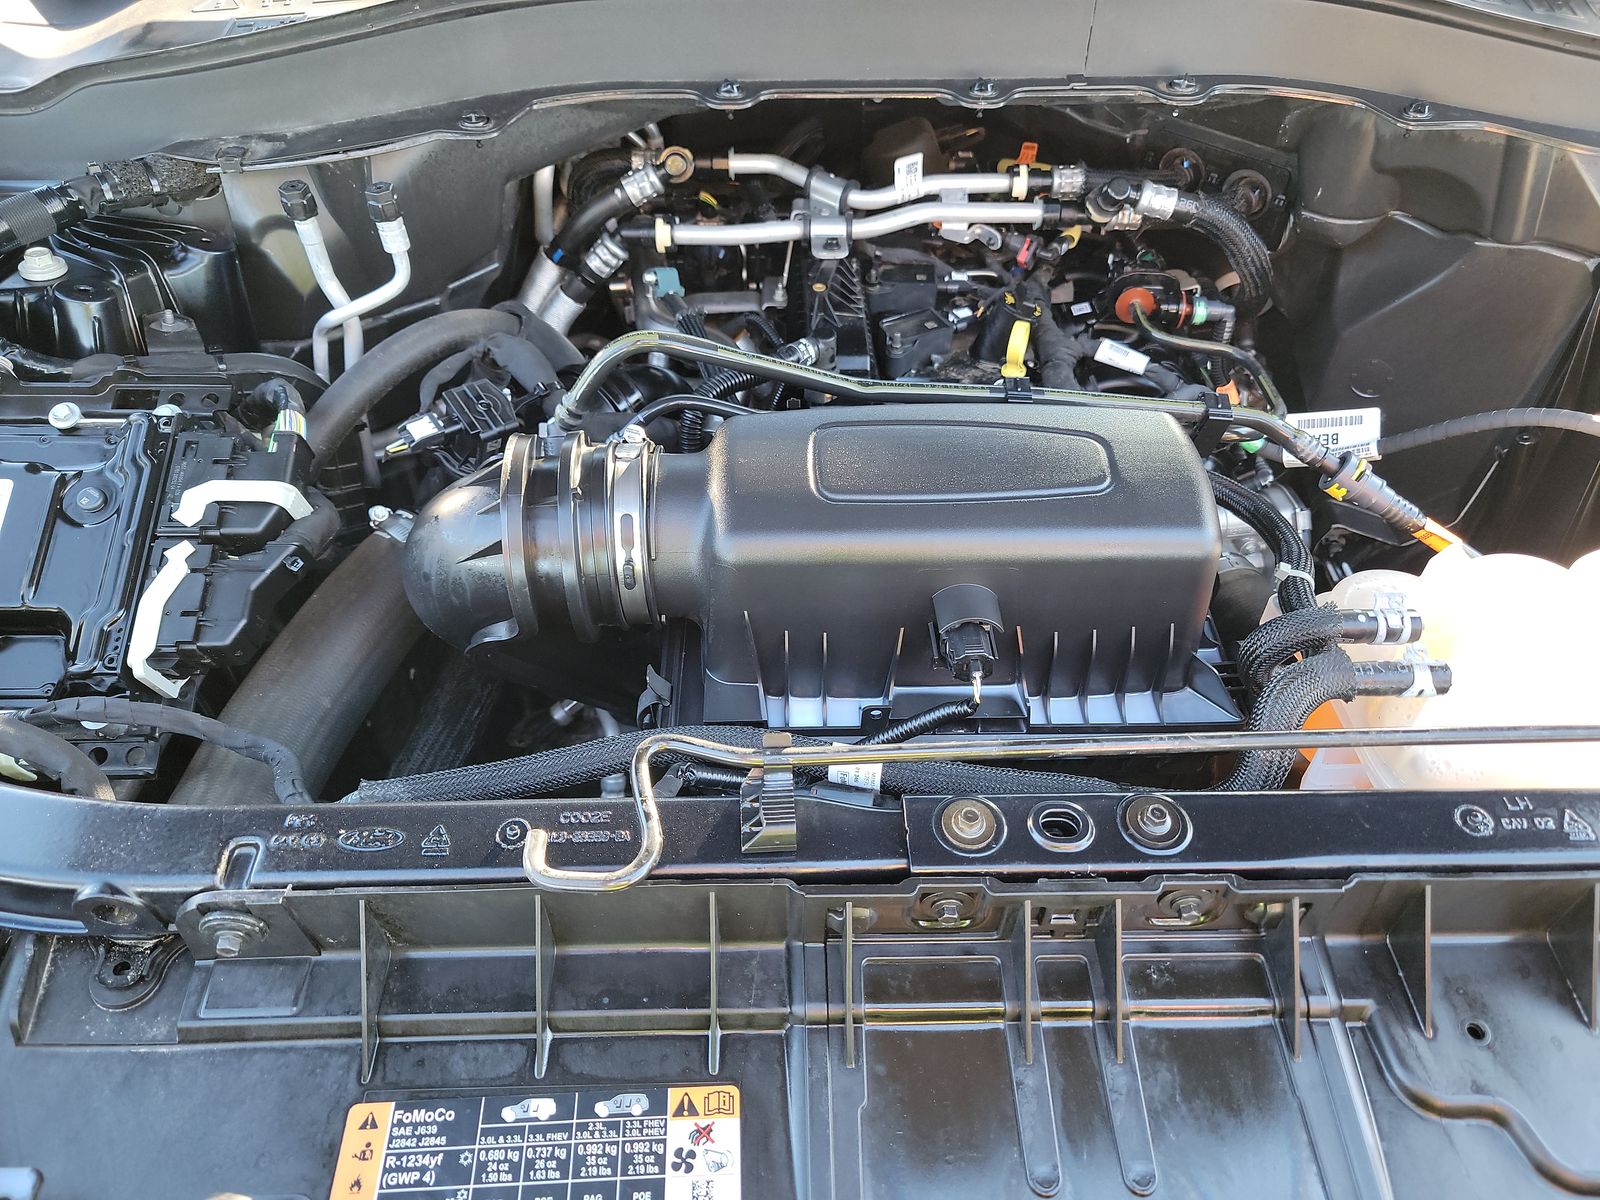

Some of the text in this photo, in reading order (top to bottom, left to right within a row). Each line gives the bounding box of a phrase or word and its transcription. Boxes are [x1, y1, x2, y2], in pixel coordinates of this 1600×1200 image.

[1502, 796, 1534, 811] LH
[393, 1108, 455, 1124] FoMoCo
[625, 1119, 665, 1129] 3.3L FHEV
[391, 1125, 438, 1136] SAE J639
[576, 1130, 618, 1139] 3.0L & 3.3L
[625, 1128, 665, 1137] 3.0L PHEV
[389, 1136, 447, 1148] J2842 J2845
[480, 1135, 522, 1145] 3.0L & 3.3L
[528, 1132, 568, 1142] 3.3L FHEV
[527, 1146, 567, 1159] 0.737 kg
[577, 1143, 618, 1156] 0.992 kg
[624, 1141, 664, 1154] 0.992 kg
[385, 1153, 444, 1169] R-1234yf
[479, 1149, 520, 1162] 0.680 kg
[586, 1156, 608, 1165] 35 oz
[633, 1154, 655, 1163] 35 oz
[486, 1162, 509, 1171] 24 oz
[534, 1160, 557, 1169] 26 oz
[627, 1164, 659, 1175] 2.19 lbs
[481, 1172, 513, 1182] 1.50 lbs
[529, 1170, 560, 1180] 1.63 lbs
[580, 1166, 612, 1177] 2.19 lbs
[382, 1171, 436, 1188] (GWP 4)
